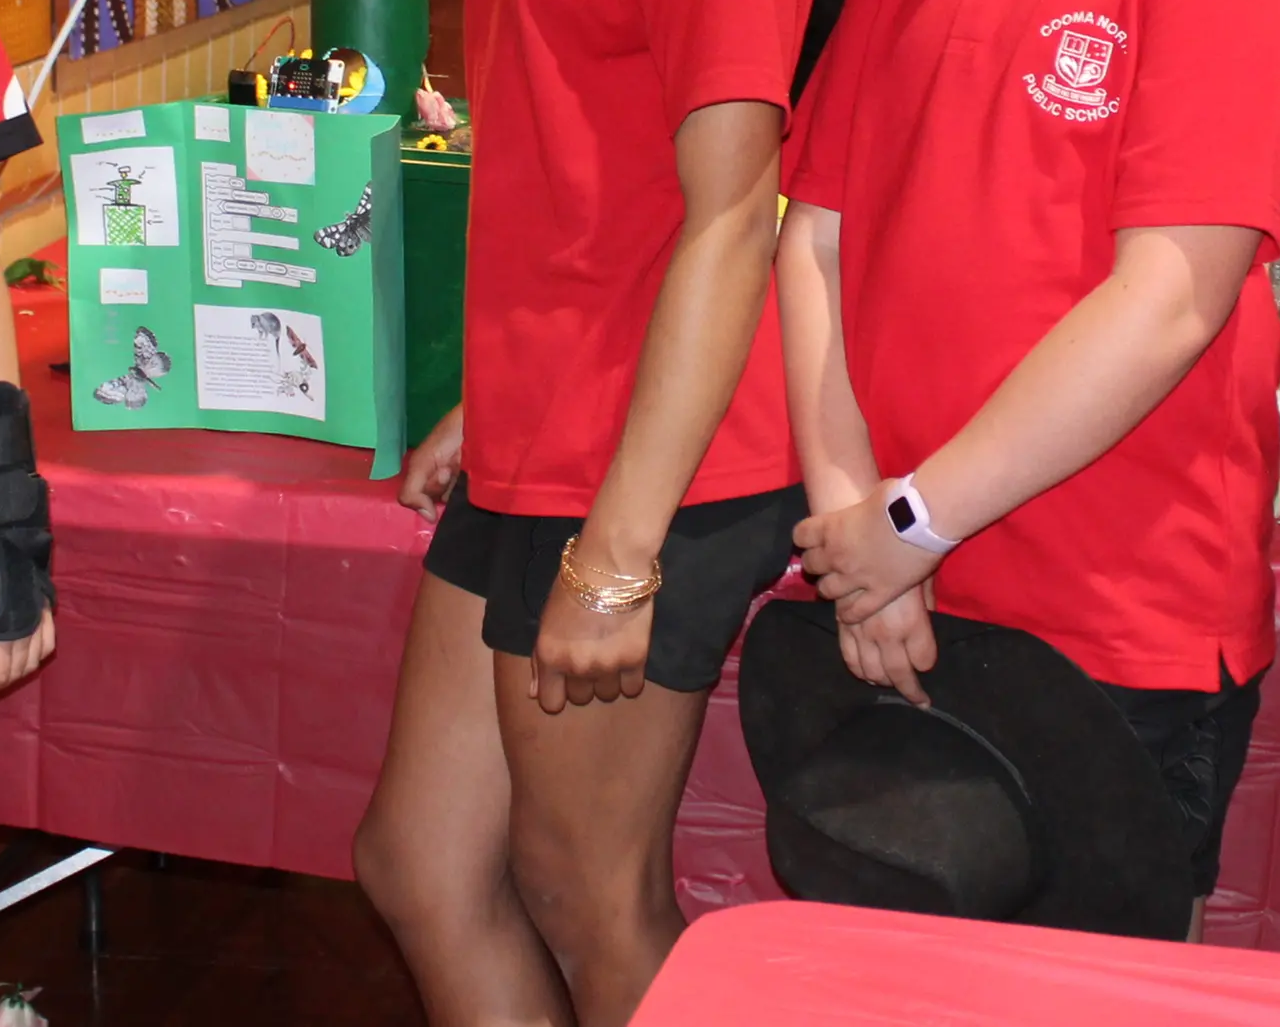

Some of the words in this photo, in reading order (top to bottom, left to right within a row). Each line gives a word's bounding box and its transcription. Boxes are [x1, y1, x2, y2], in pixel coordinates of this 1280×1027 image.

[1039, 11, 1096, 37] COOMA
[1095, 14, 1128, 55] NOR
[1022, 73, 1063, 117] PUBLIC
[1063, 96, 1121, 123] SCHOO
